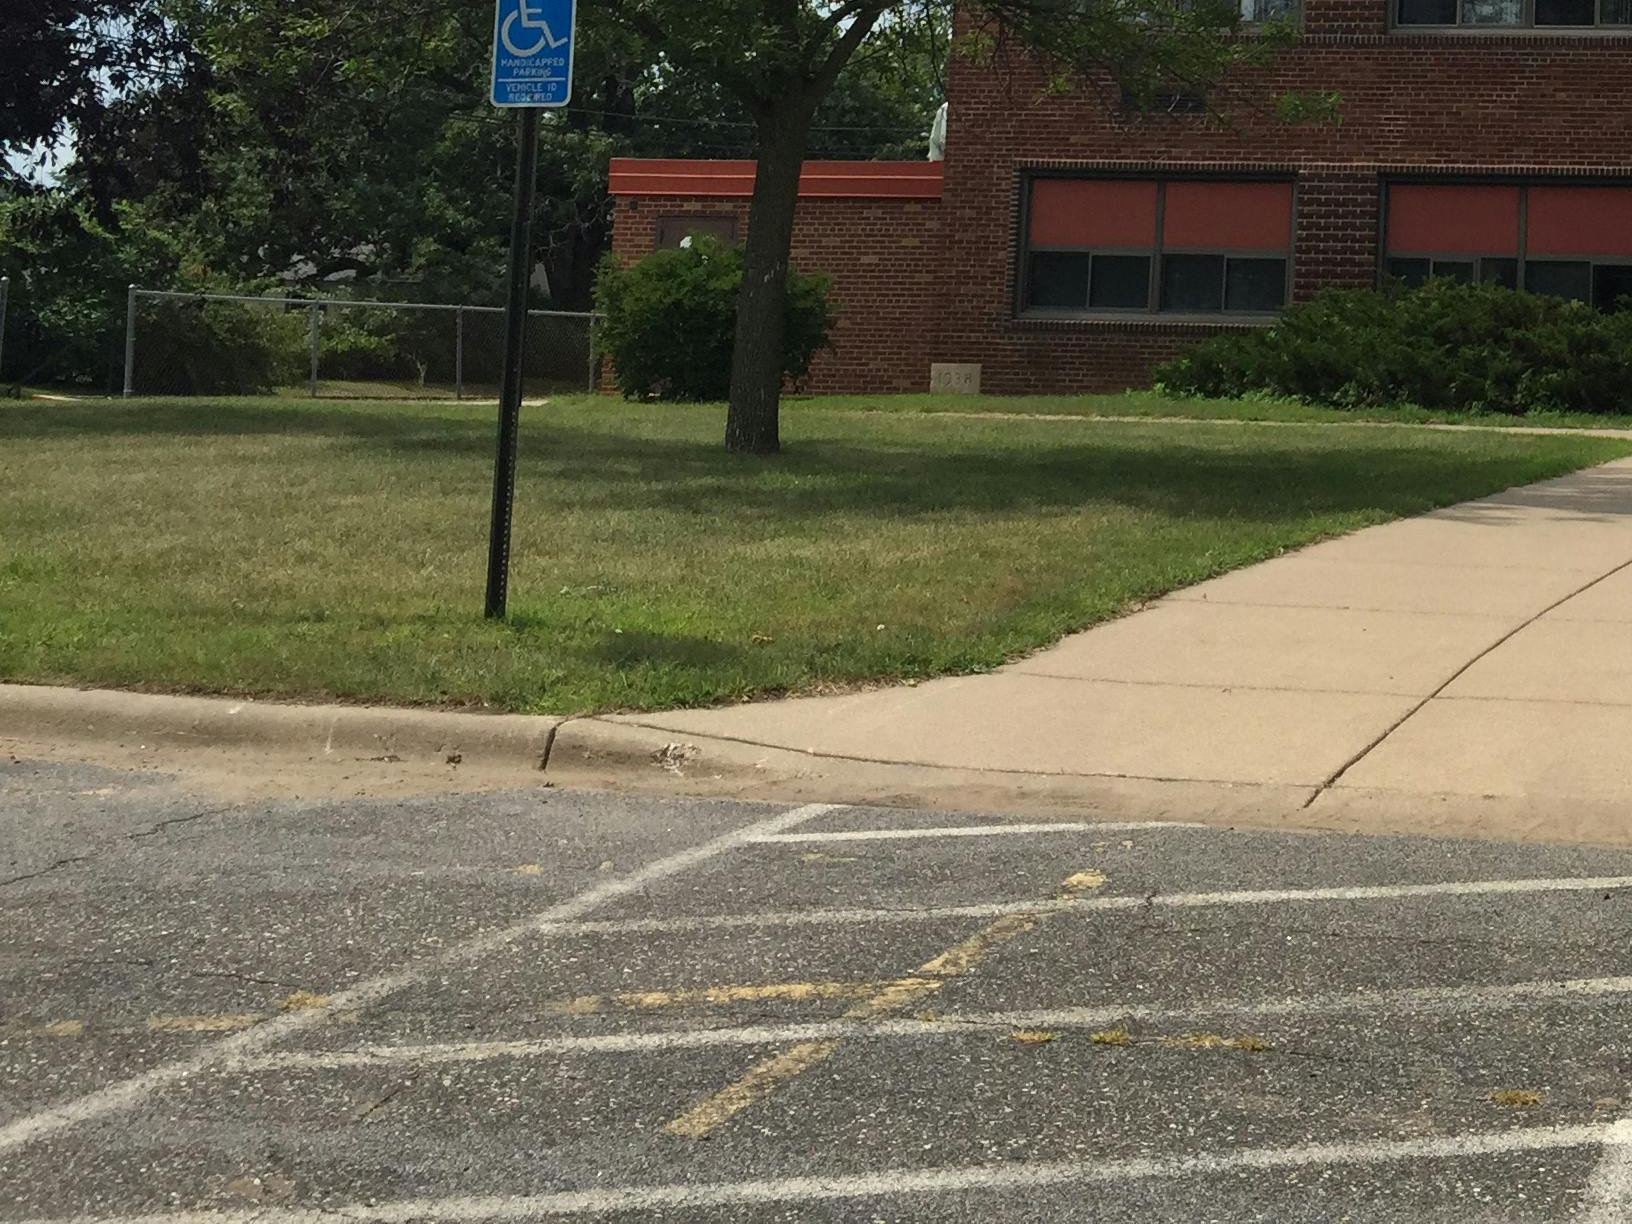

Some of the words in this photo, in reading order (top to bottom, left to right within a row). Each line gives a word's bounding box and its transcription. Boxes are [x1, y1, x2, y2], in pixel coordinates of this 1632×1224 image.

[501, 57, 565, 67] HANDICAPPED
[513, 68, 552, 77] PARKING
[506, 82, 543, 92] VEHICLE
[547, 82, 557, 92] ID
